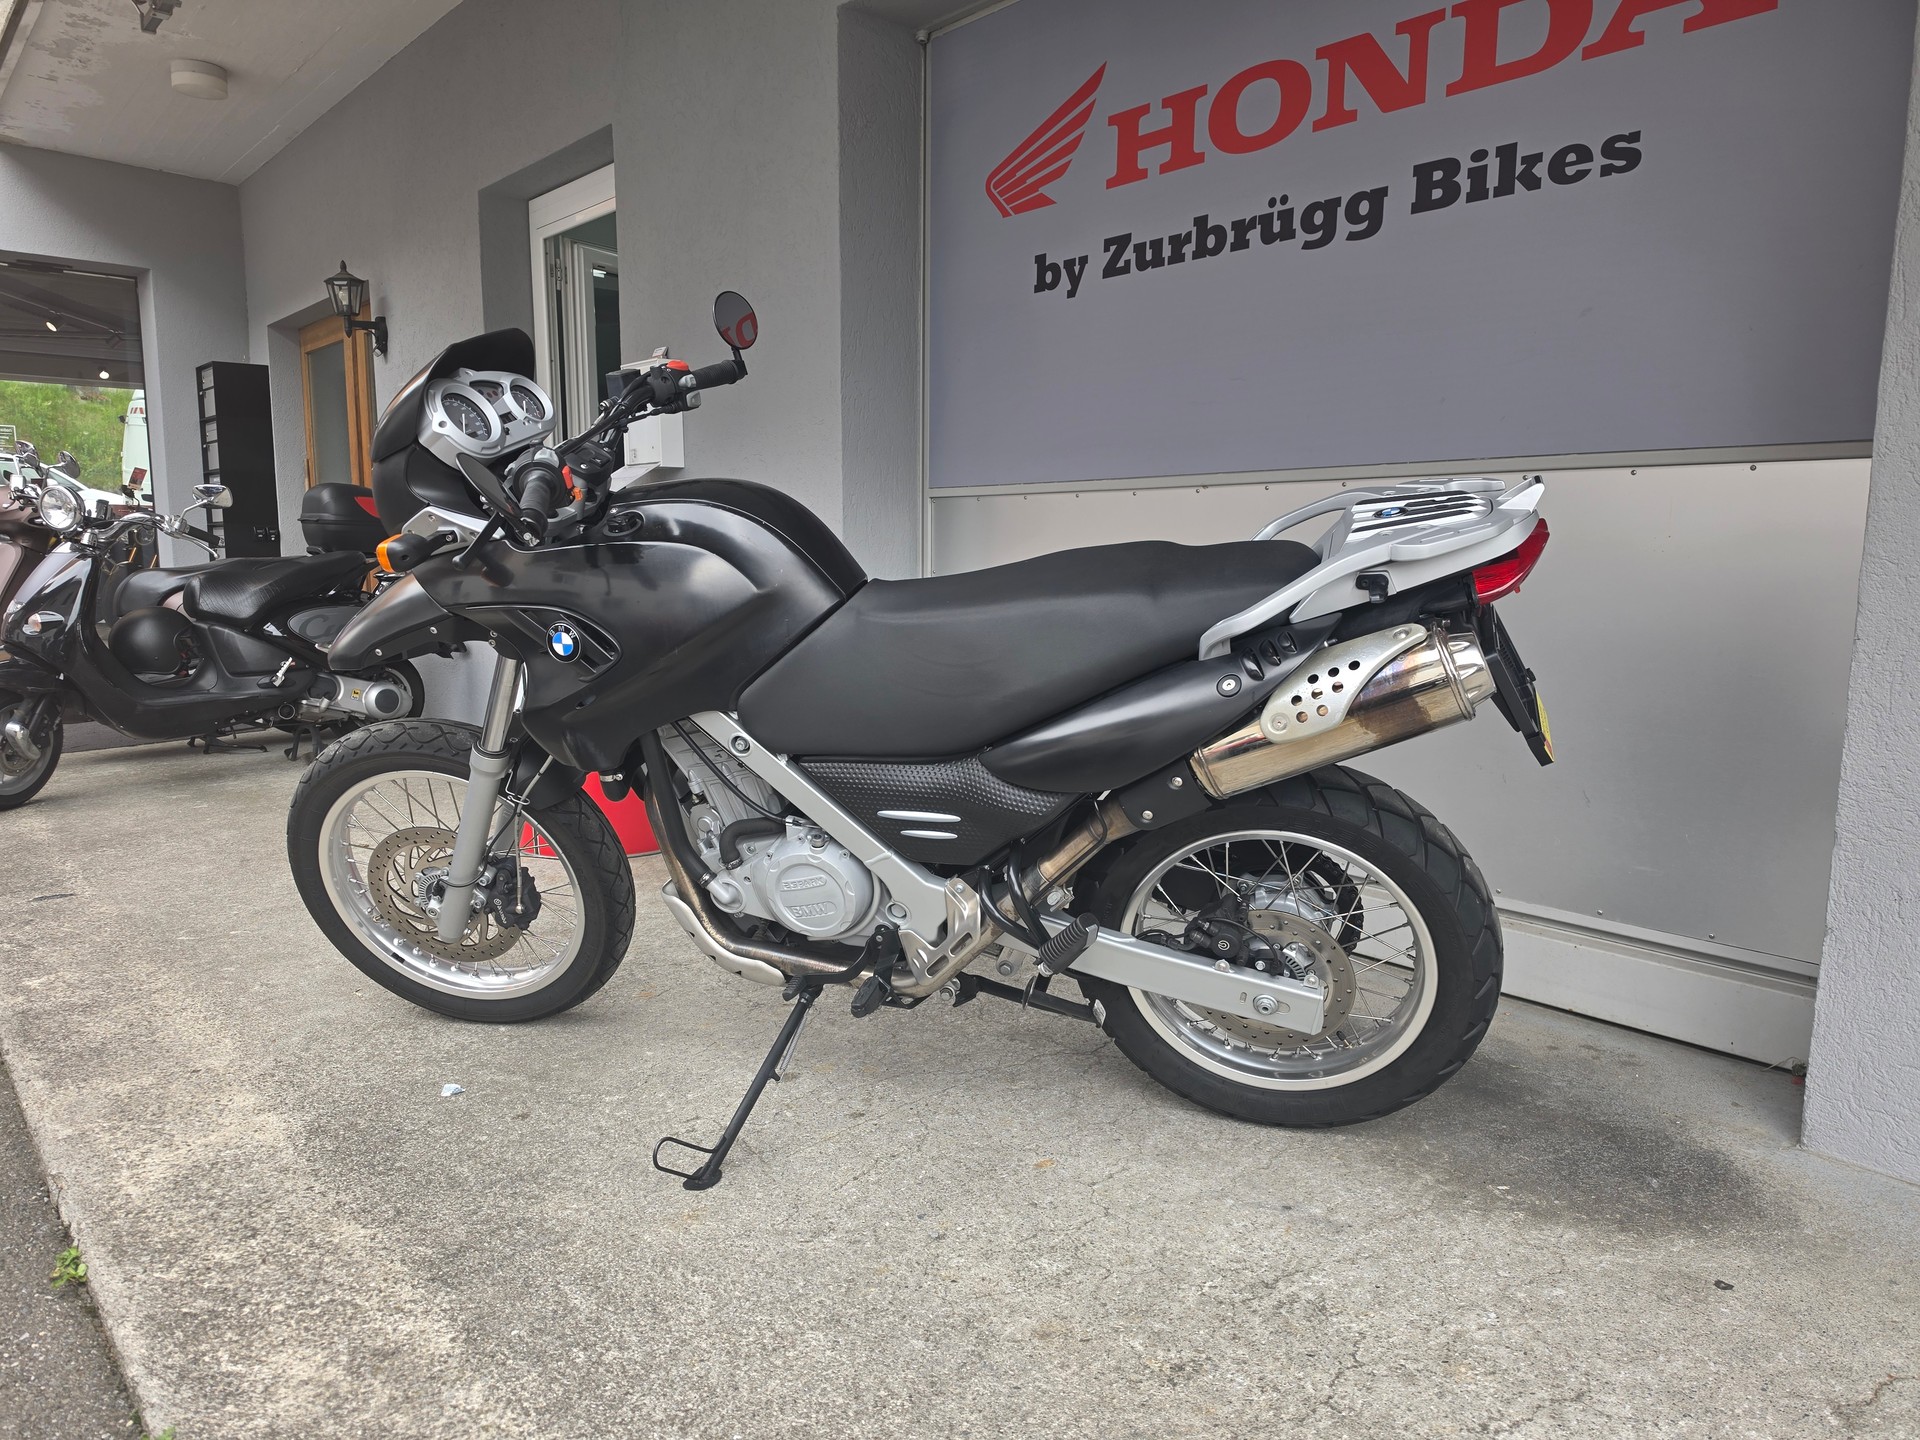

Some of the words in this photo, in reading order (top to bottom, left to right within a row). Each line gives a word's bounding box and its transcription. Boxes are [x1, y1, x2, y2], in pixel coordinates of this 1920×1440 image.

[1034, 253, 1088, 299] by
[1103, 185, 1388, 280] Zurbrügg
[1411, 130, 1642, 215] Bikes
[791, 902, 828, 918] BMW
